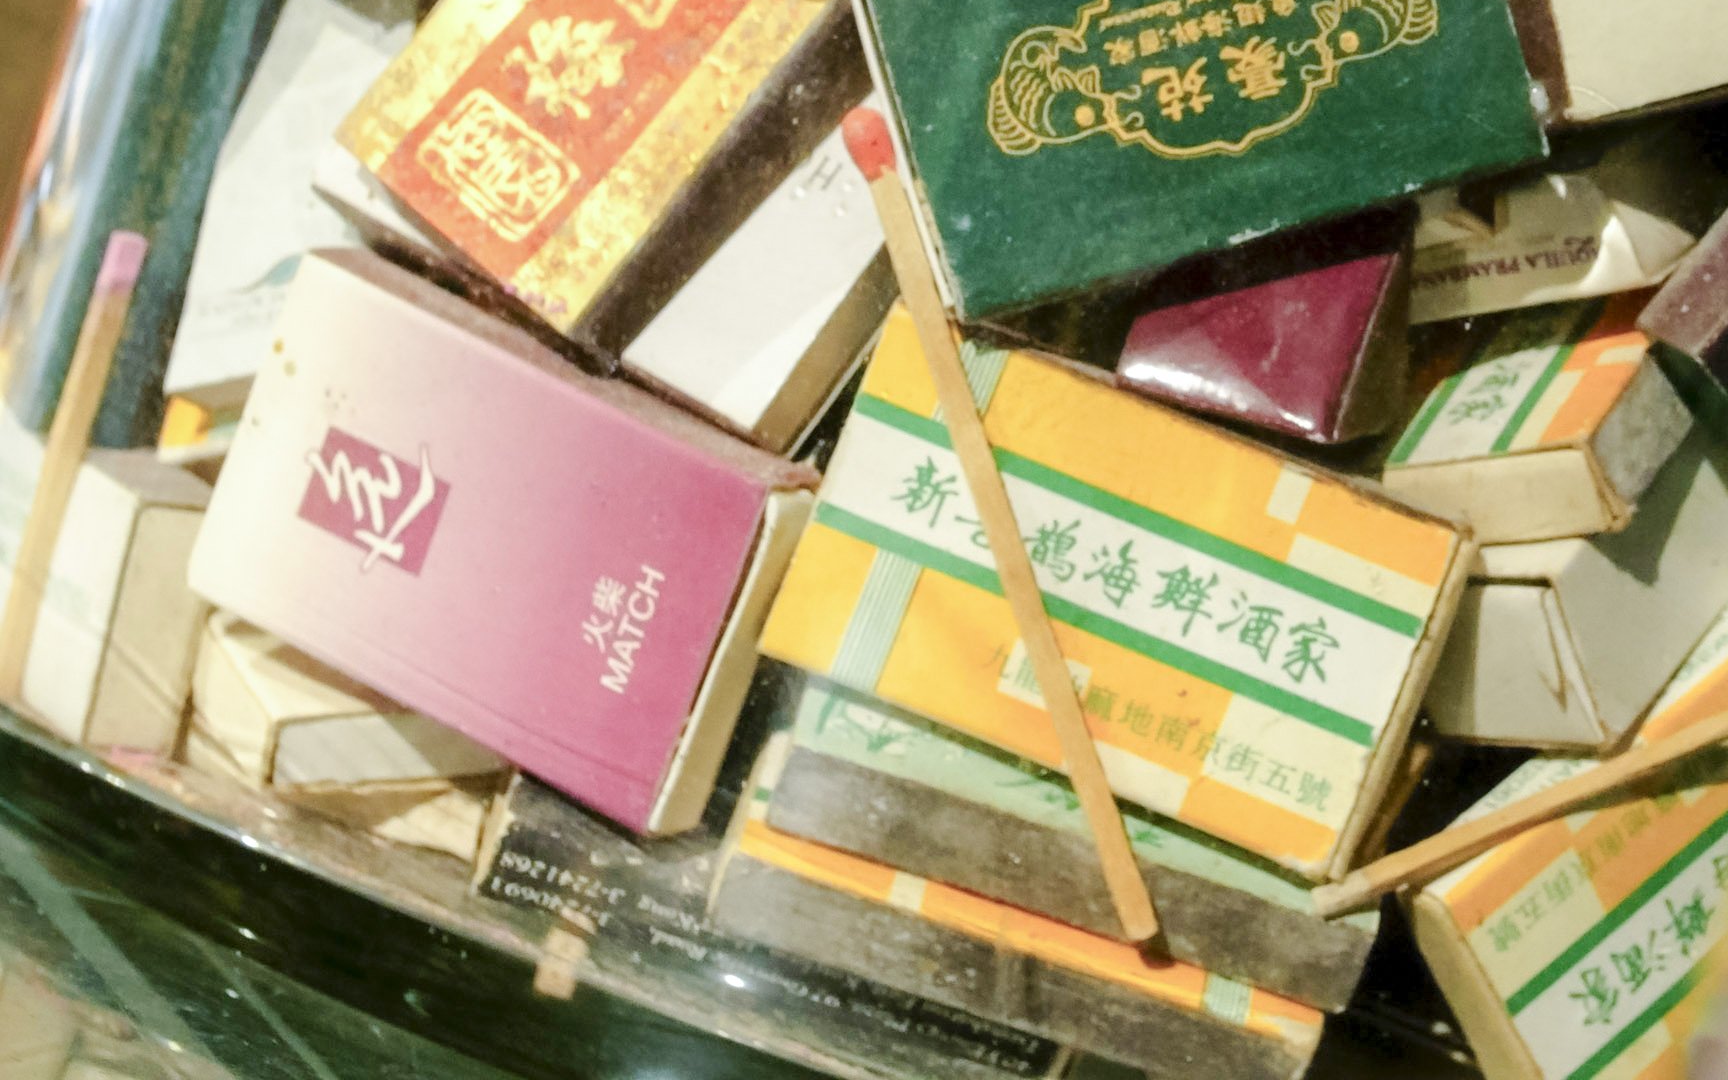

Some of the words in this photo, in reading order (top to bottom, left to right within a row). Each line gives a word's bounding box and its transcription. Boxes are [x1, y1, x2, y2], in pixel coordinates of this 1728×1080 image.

[581, 576, 626, 653] 火柴
[599, 566, 665, 694] MATCH
[893, 457, 1340, 684] 新鵲海鮮酒家
